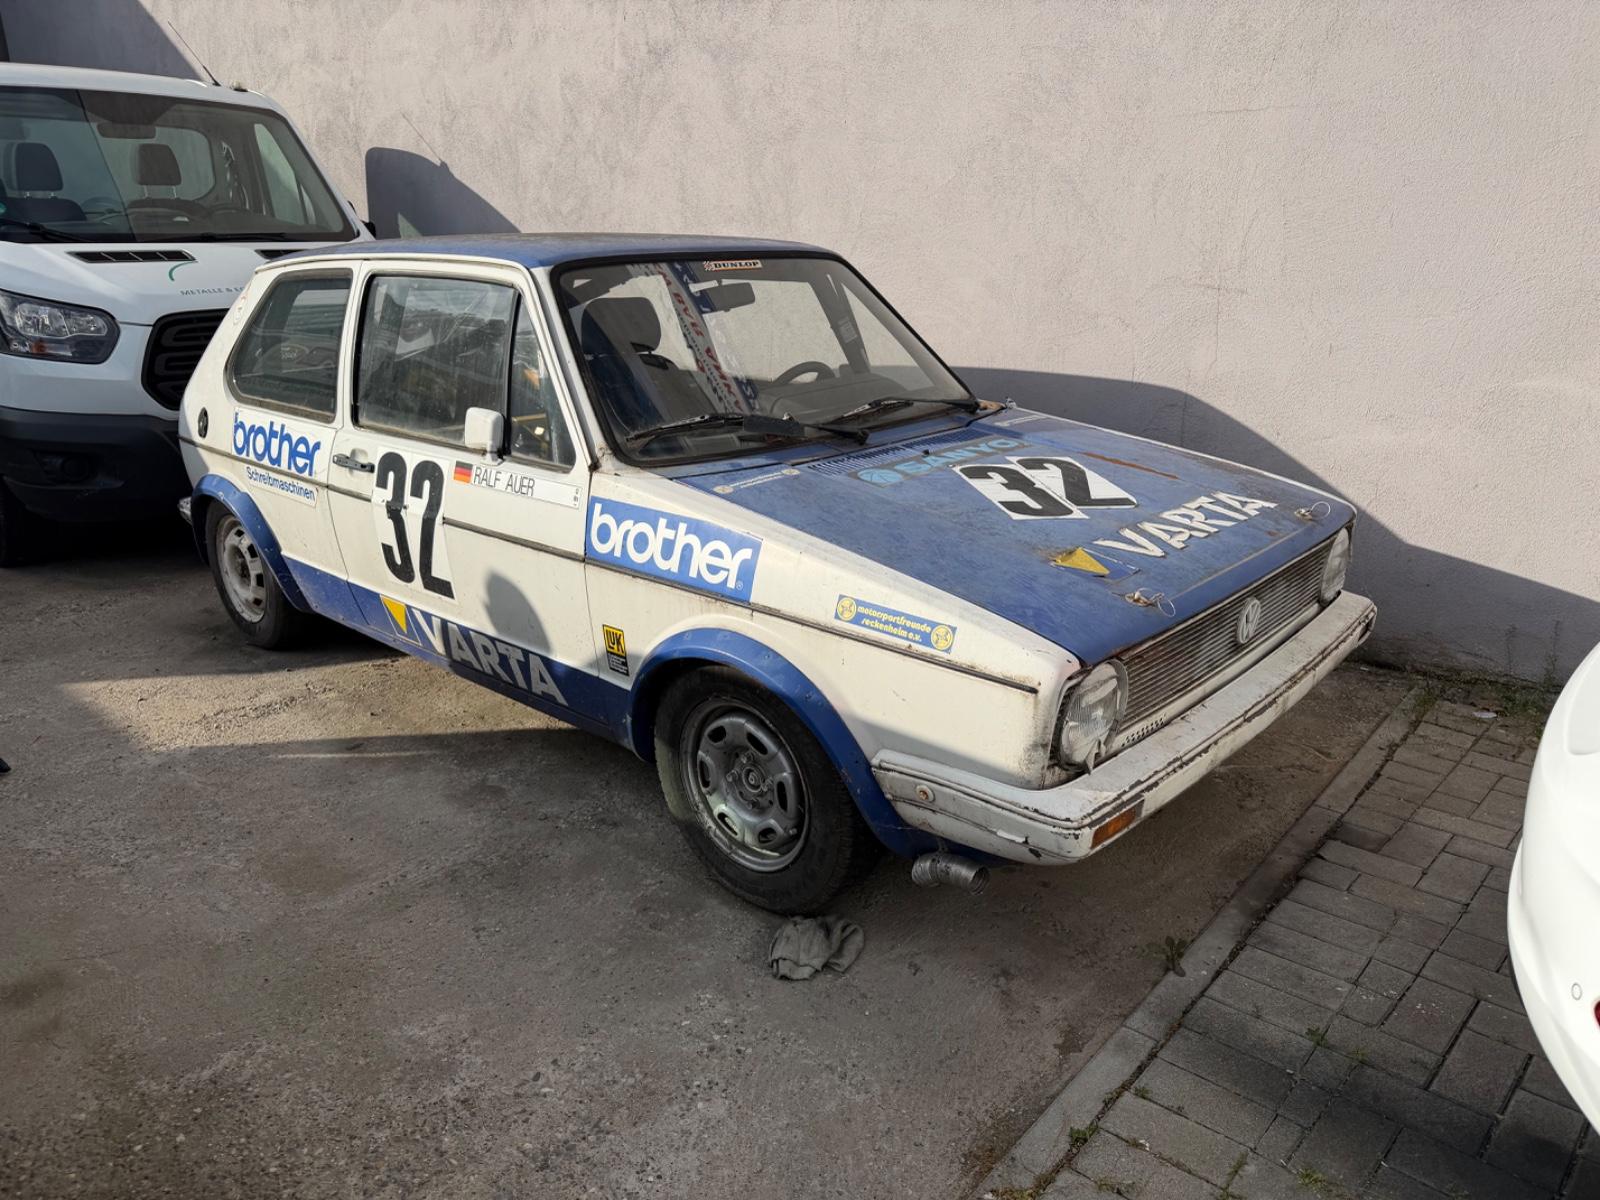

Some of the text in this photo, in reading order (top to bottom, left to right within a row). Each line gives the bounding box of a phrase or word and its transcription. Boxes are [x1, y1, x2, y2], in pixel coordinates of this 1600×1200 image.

[180, 287, 224, 296] METALLE
[713, 261, 759, 269] DUNLOP
[232, 412, 321, 477] brother
[894, 438, 1021, 475] SANYO
[246, 466, 317, 502] Schreibmaschinen
[473, 466, 536, 497] RALF AUER
[958, 457, 1137, 518] 32
[376, 452, 455, 600] 32
[590, 503, 753, 590] brother
[1092, 490, 1279, 558] VARTA
[410, 608, 568, 706] VARTA
